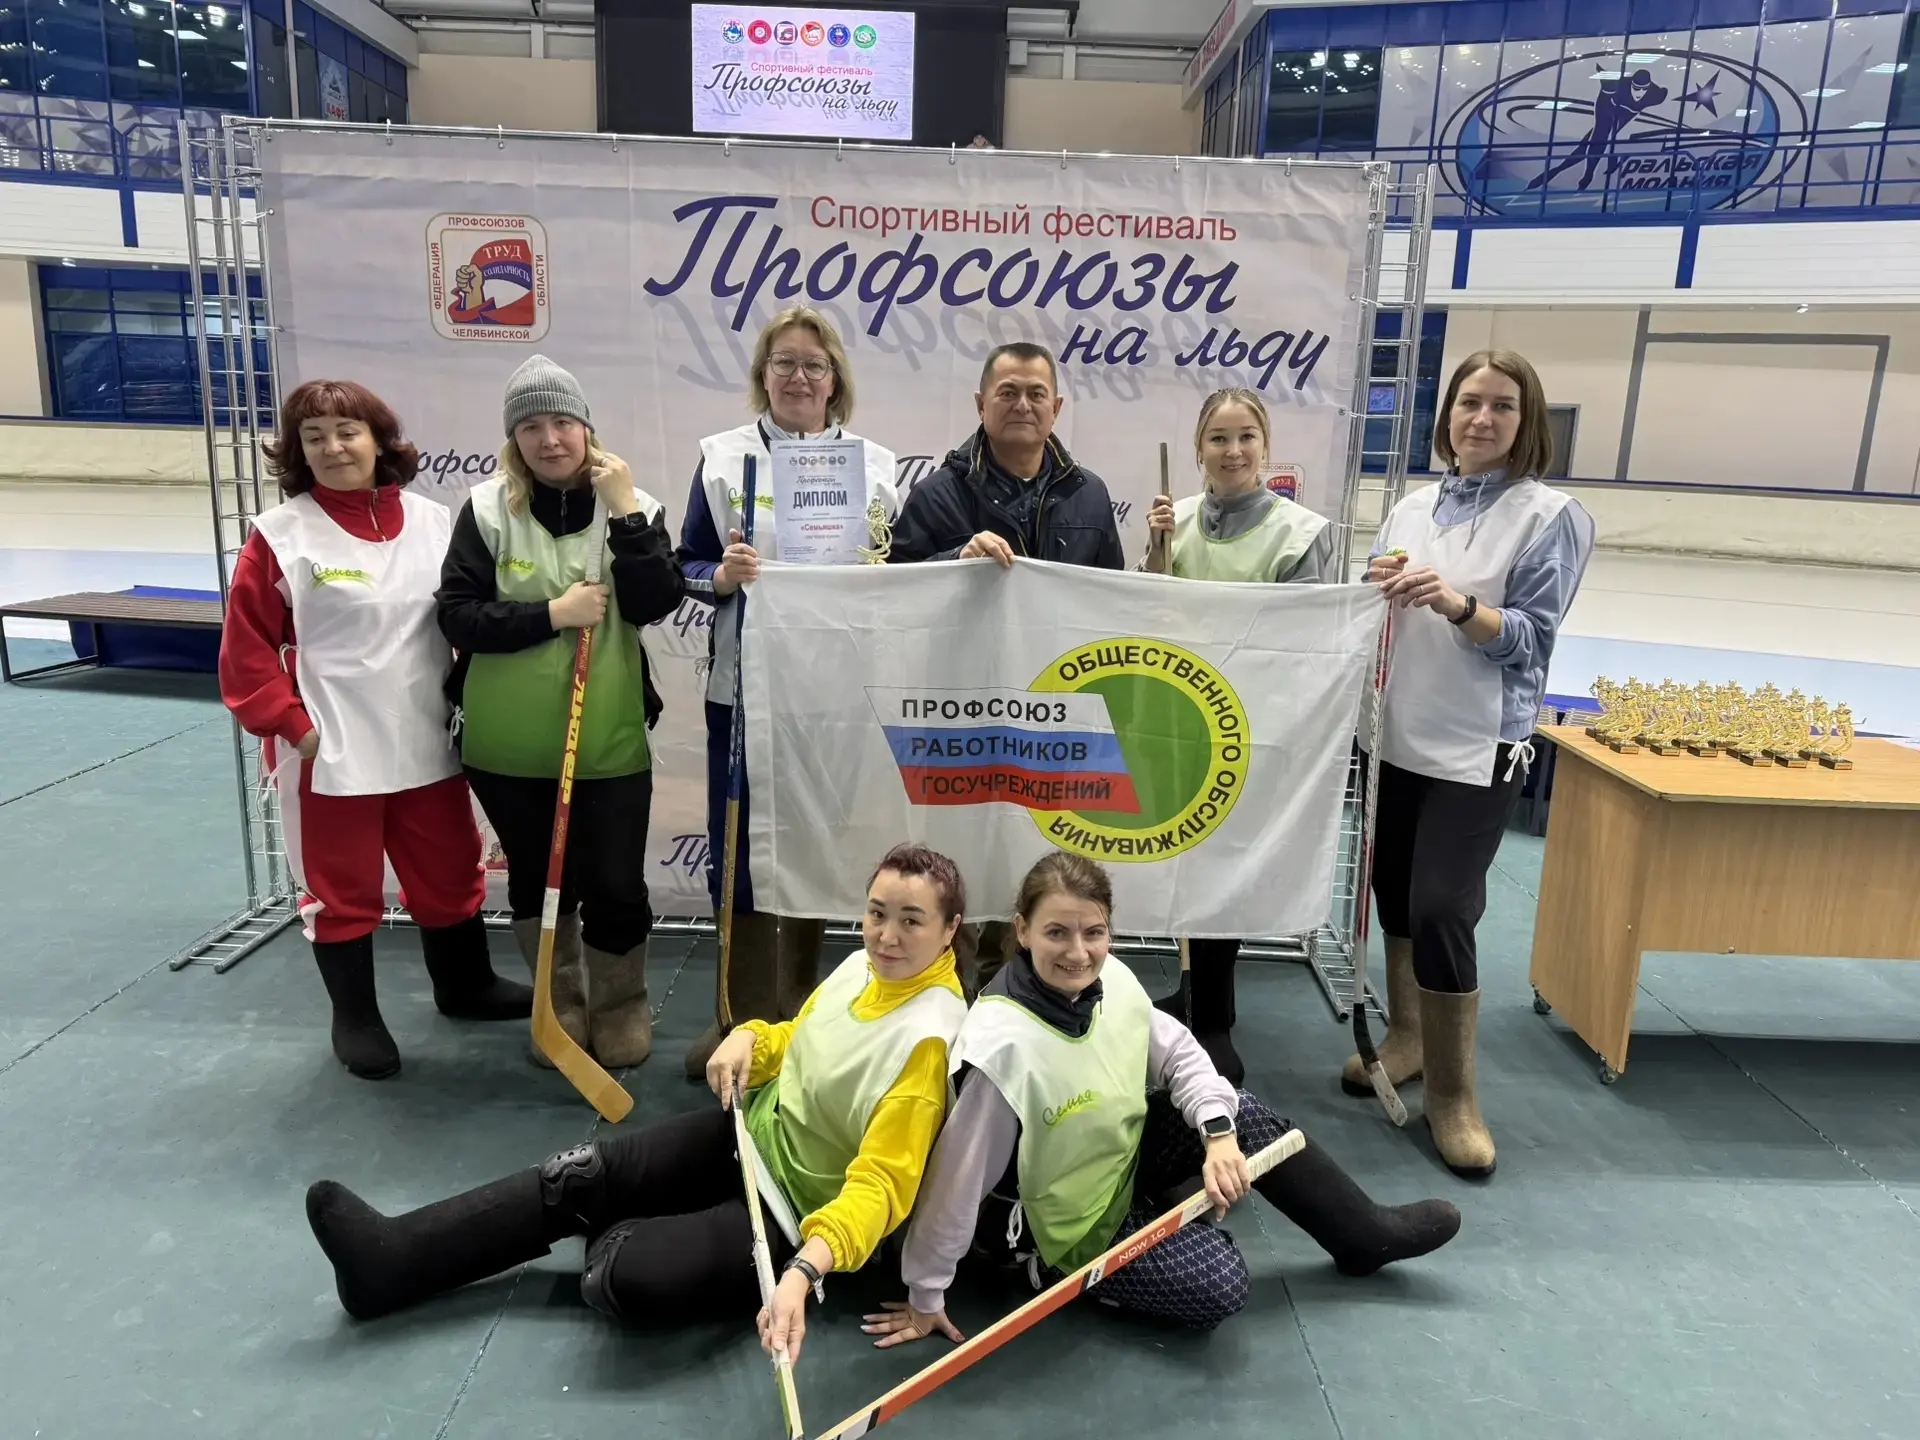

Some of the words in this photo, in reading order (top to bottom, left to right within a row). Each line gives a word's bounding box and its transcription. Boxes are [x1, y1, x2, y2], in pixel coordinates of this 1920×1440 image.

[703, 63, 872, 101] Профсоюзы
[751, 62, 814, 75] Спортивный
[816, 64, 873, 76] фестиваль
[822, 96, 847, 110] на
[854, 99, 899, 117] льду
[448, 216, 525, 228] ПРОФСОЮЗОВ
[810, 195, 1031, 237] Спортивный
[1042, 204, 1238, 244] фестиваль
[482, 244, 522, 259] ТРУД
[430, 242, 444, 310] ФЕДЕРАЦИЯ
[483, 264, 531, 282] СОЛИДАРНОСТЬ
[535, 254, 546, 307] ОБЛАСТИ
[642, 195, 1240, 338] Профсоюзы
[452, 328, 530, 339] ЧЕЛЯБИНСКОЙ
[1058, 323, 1149, 366] на
[1174, 327, 1331, 391] льду
[792, 490, 848, 509] ДИПЛОМ
[901, 698, 1068, 723] ПРОФСОЮЗ
[1058, 644, 1242, 763] ОБЩЕСТВЕННОГО
[910, 735, 1088, 761] РАБОТНИКОВ
[921, 773, 1112, 804] ГОСУЧРЕЖДЕНИЙ
[1048, 769, 1237, 856] ОБСЛУЖИВАНИЯ
